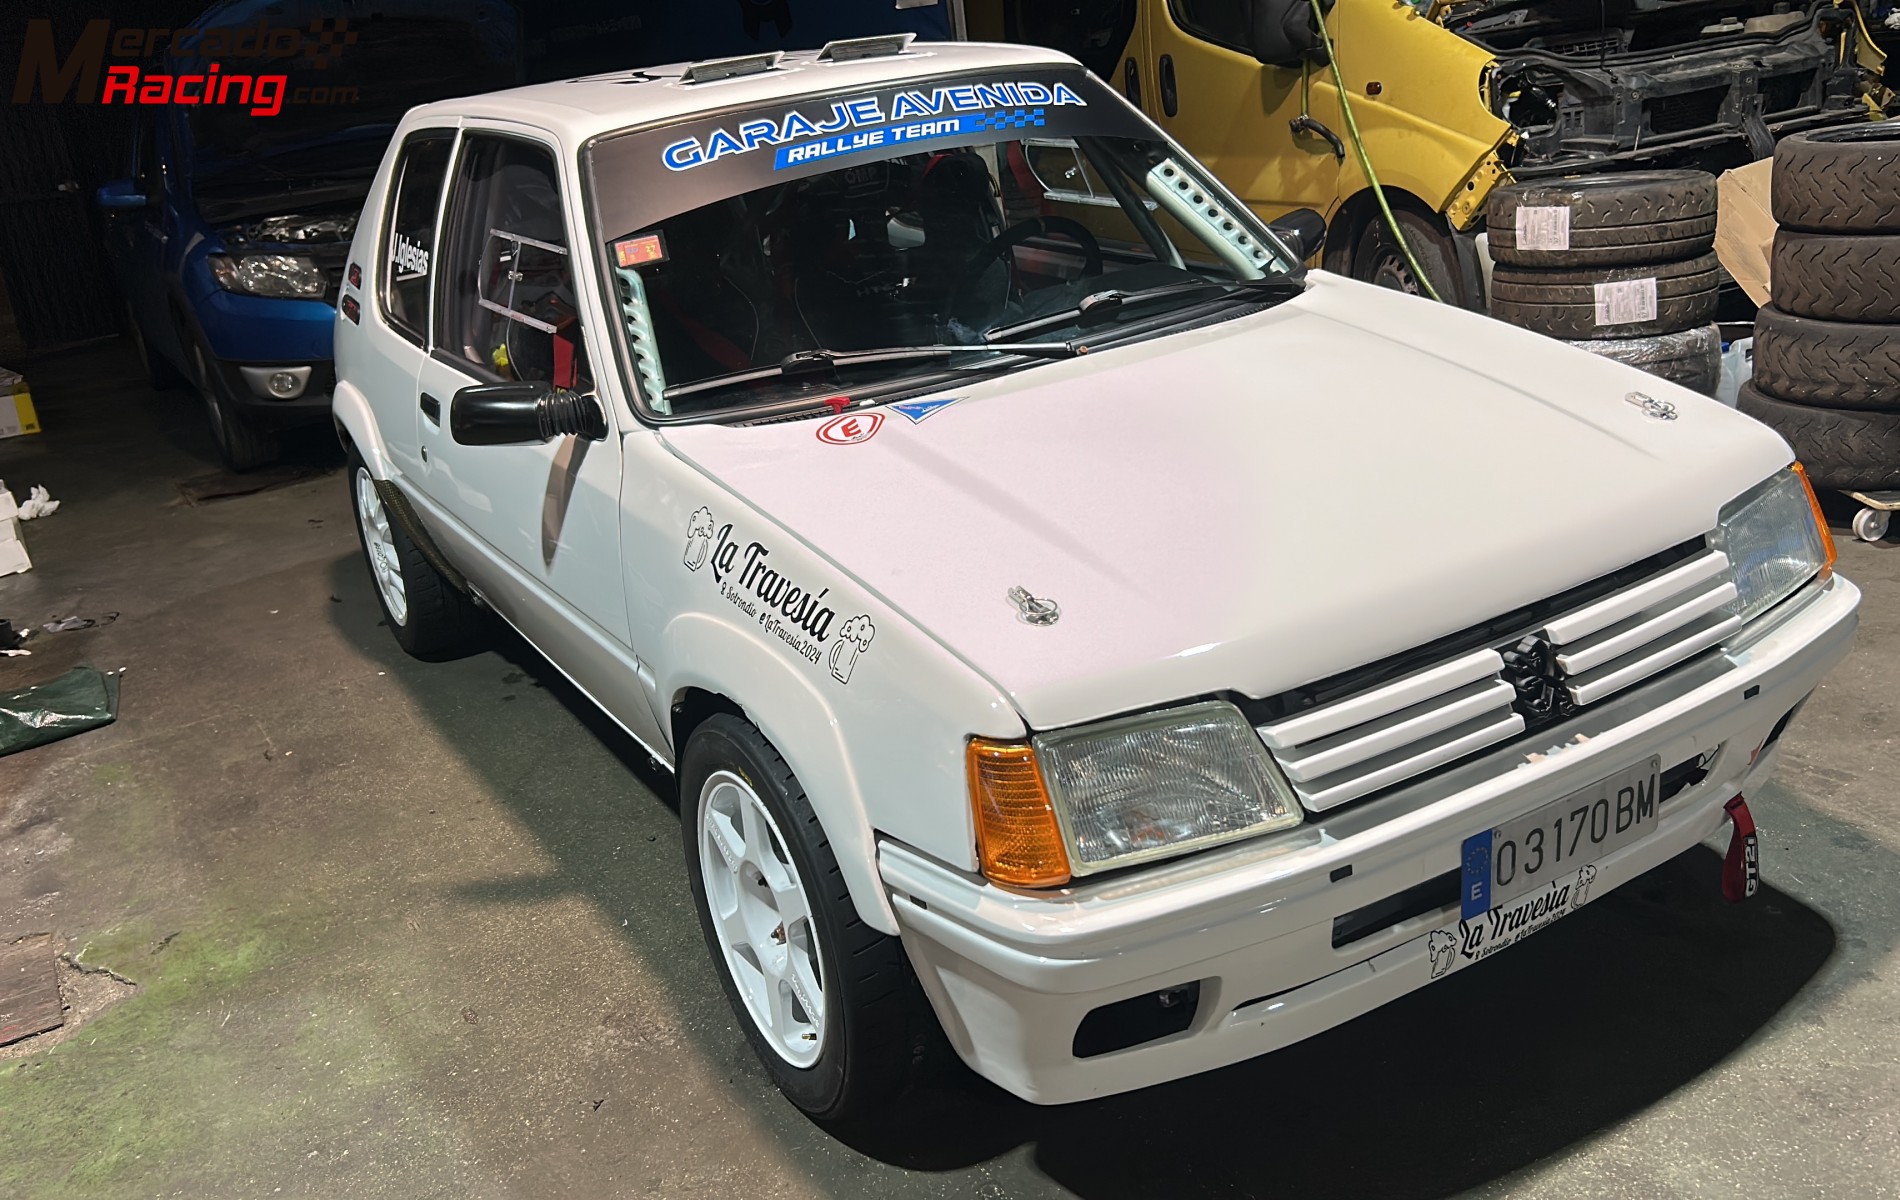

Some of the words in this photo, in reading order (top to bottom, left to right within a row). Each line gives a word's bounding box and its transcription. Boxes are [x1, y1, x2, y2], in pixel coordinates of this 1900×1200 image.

[661, 98, 886, 172] GARAJE
[891, 82, 1088, 120] AVENIDA
[787, 131, 883, 164] RALLYE
[893, 118, 960, 142] TEAM
[841, 418, 861, 437] E
[711, 523, 740, 584] La
[738, 541, 836, 643] Travesía
[1471, 881, 1483, 901] E
[1458, 918, 1485, 960] La
